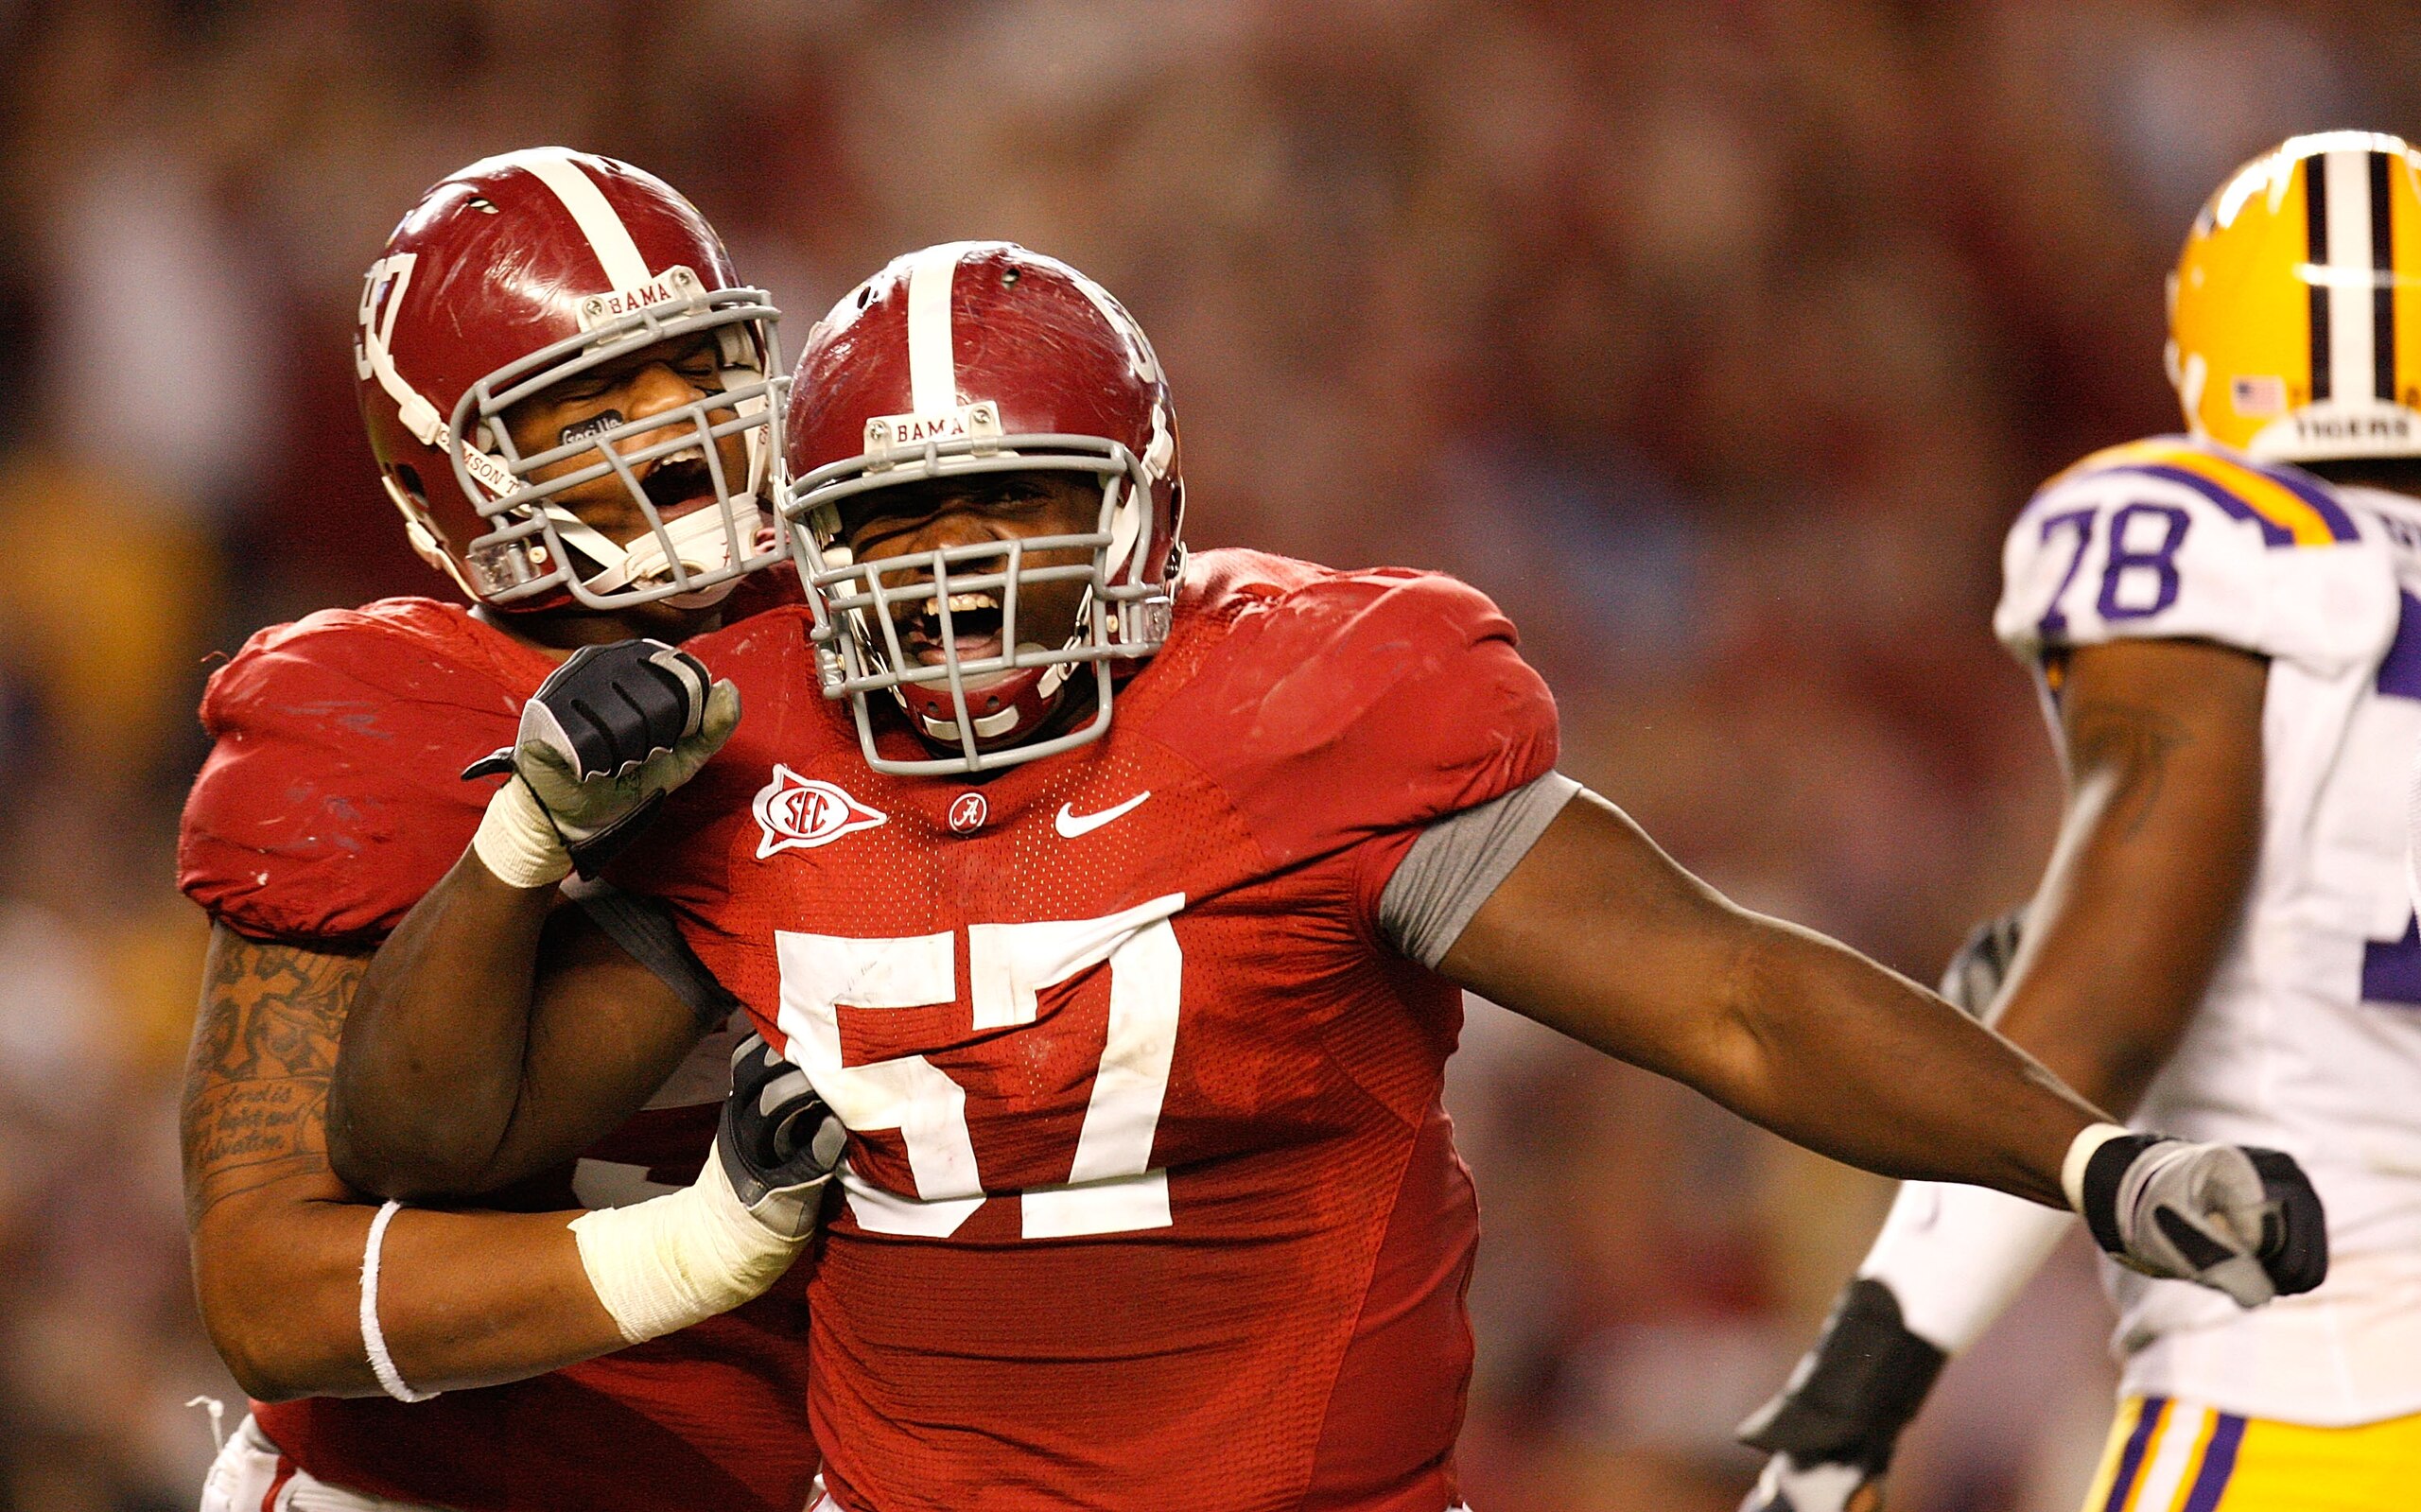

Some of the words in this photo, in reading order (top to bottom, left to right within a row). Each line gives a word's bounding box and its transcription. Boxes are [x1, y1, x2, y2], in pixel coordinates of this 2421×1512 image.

[608, 283, 671, 314] BAMA
[897, 418, 965, 443] BAMA
[2038, 502, 2191, 631] 78
[784, 791, 829, 834] SEC
[775, 892, 1186, 1239] 57
